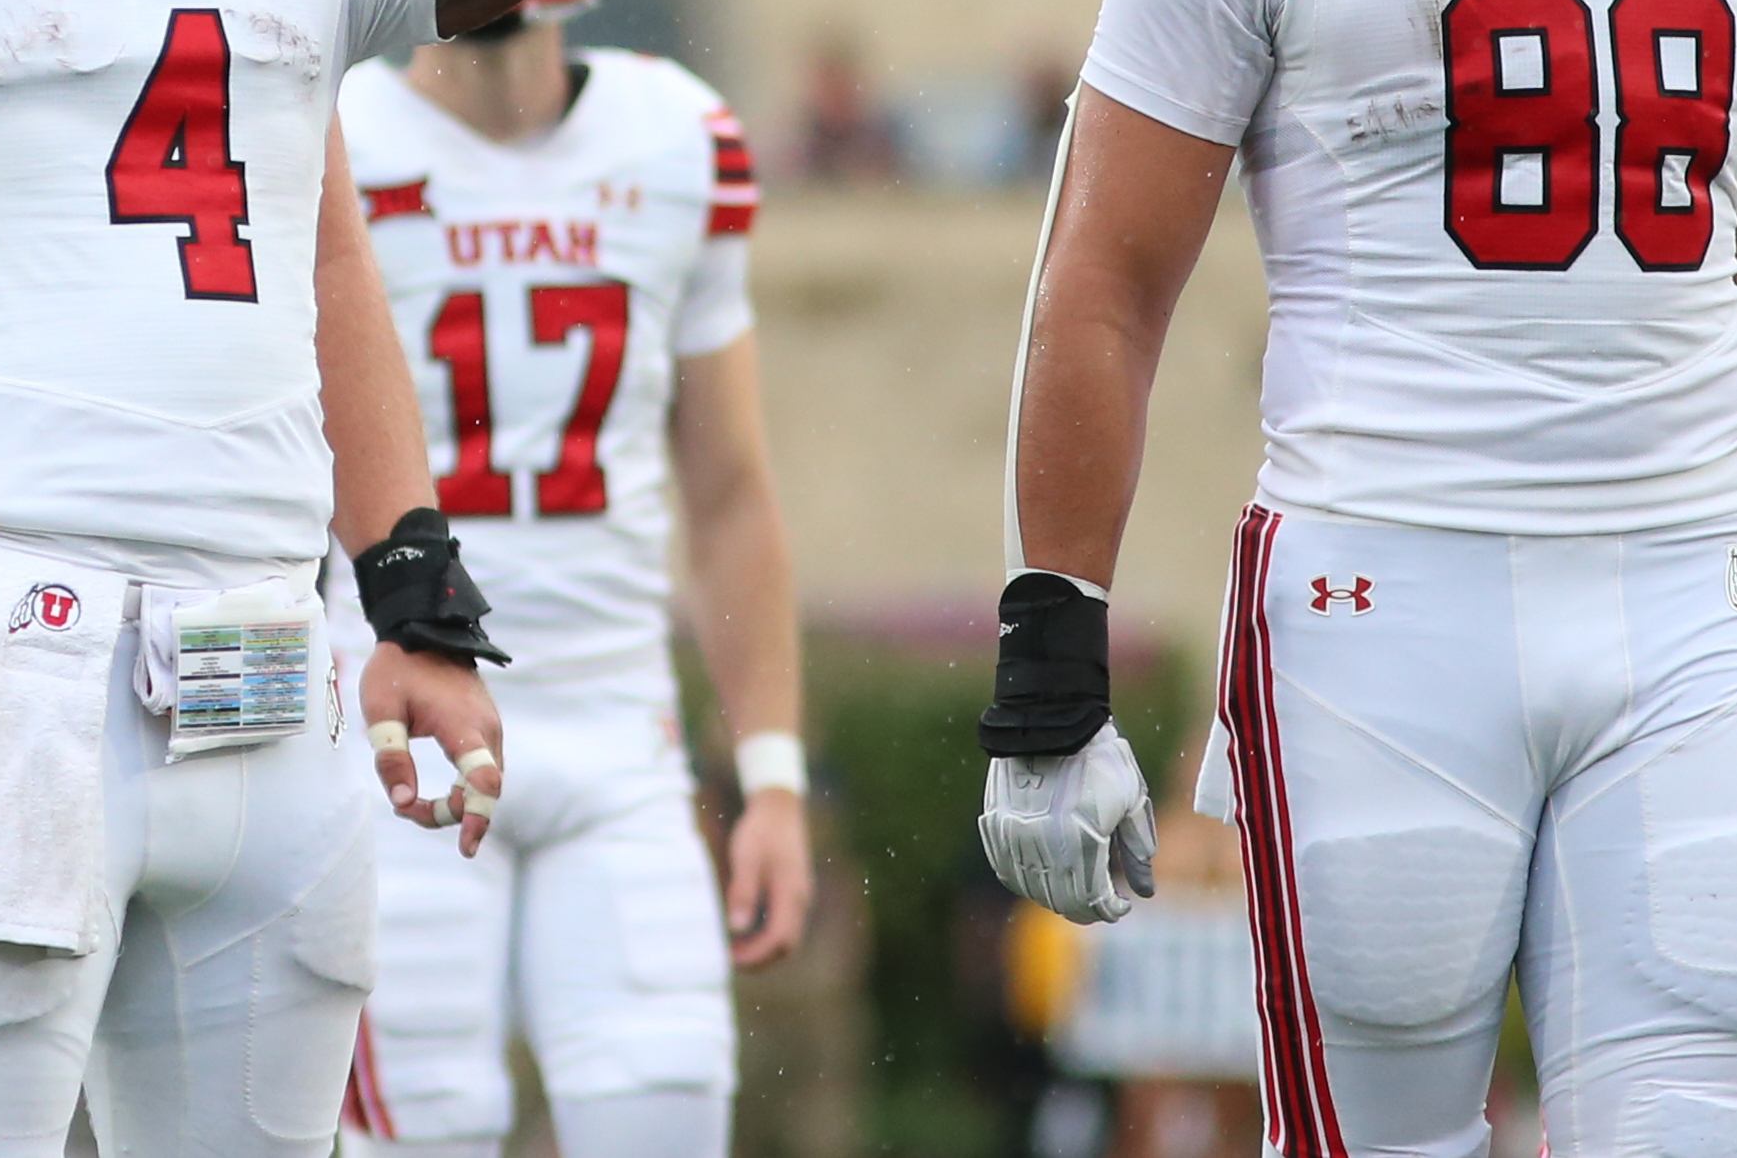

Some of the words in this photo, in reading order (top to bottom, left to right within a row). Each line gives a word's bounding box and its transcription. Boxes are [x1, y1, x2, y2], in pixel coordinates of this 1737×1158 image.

[105, 8, 259, 304] 4
[444, 221, 599, 267] UTAH
[426, 282, 631, 519] 17
[41, 591, 74, 628] U
